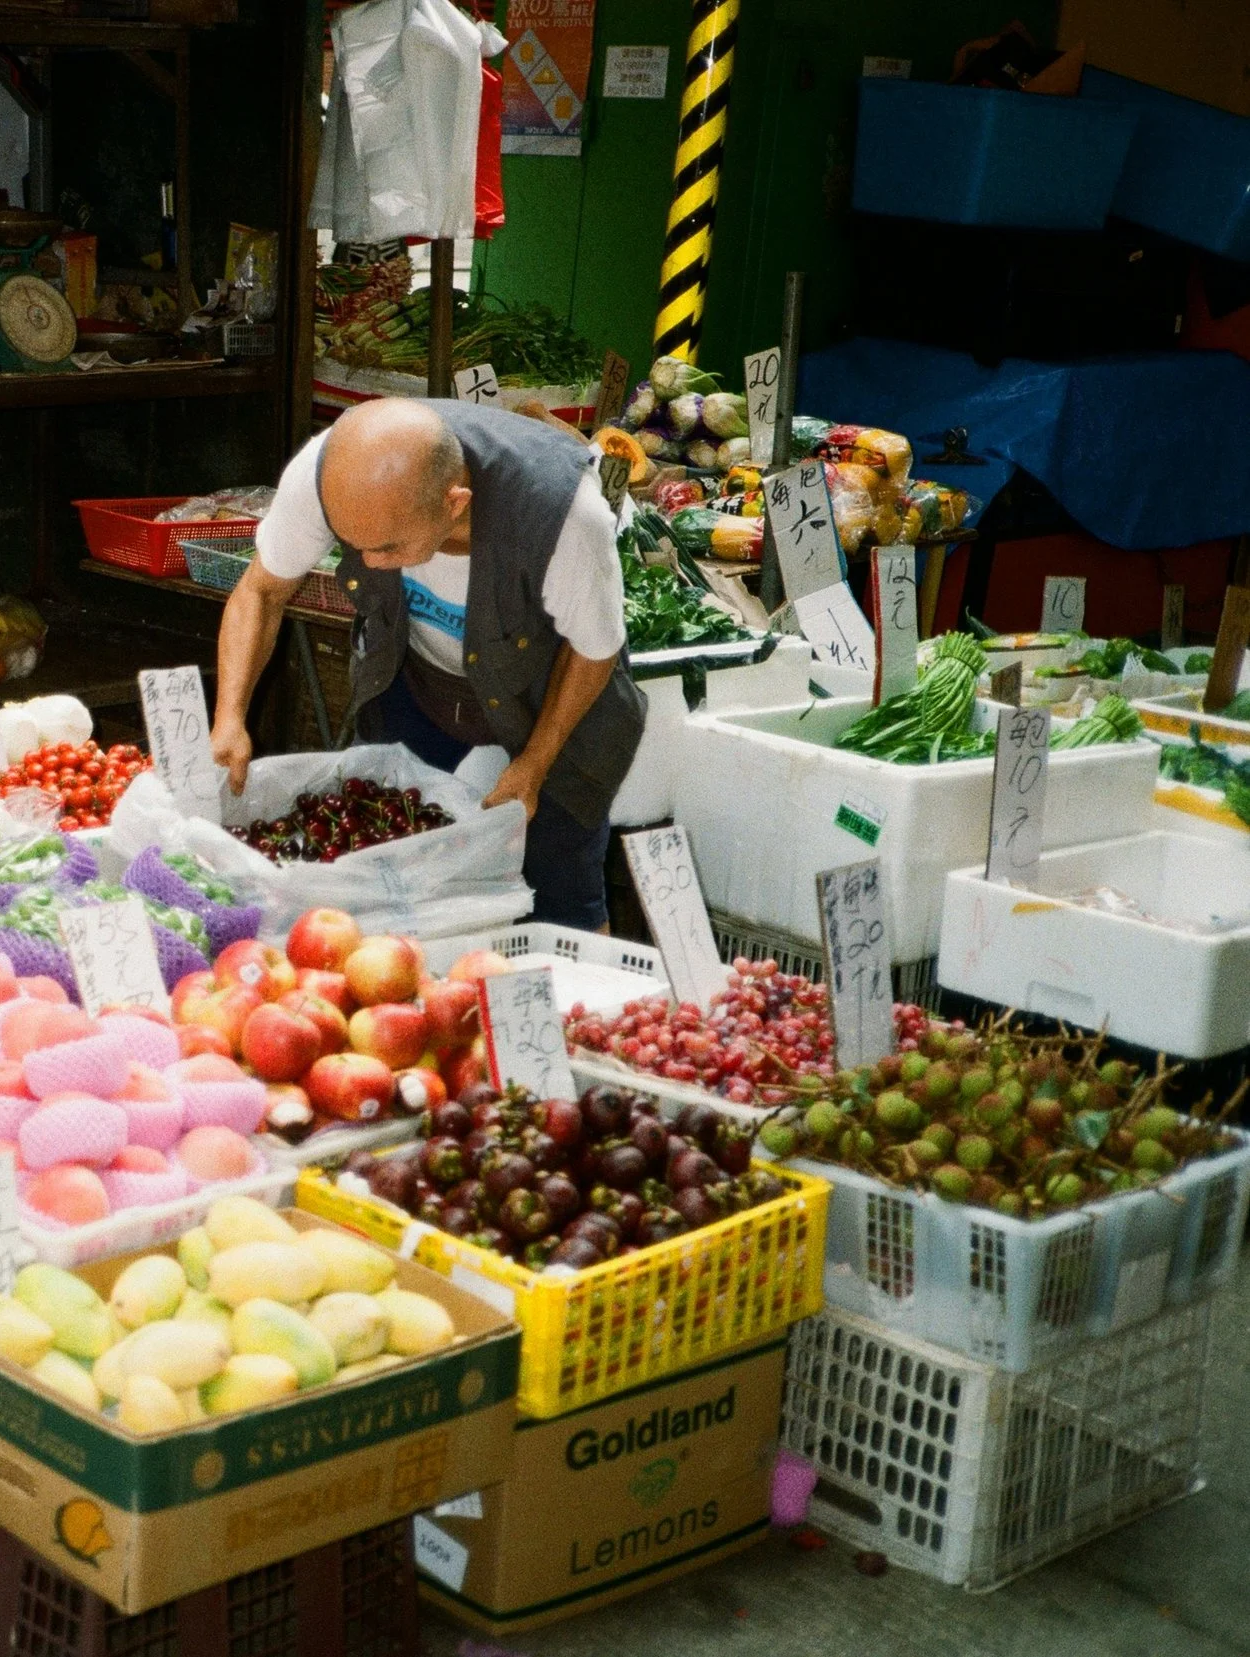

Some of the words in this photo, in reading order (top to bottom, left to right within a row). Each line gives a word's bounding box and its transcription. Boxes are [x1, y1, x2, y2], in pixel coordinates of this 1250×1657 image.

[748, 353, 779, 388] 20
[605, 461, 628, 489] 10
[885, 556, 916, 586] 12
[168, 708, 202, 744] 70
[1008, 754, 1042, 795] 10
[655, 865, 692, 901] 20
[846, 917, 885, 960] 20
[516, 1019, 561, 1055] 20
[565, 1384, 736, 1471] Goldland
[569, 1499, 719, 1577] Lemons
